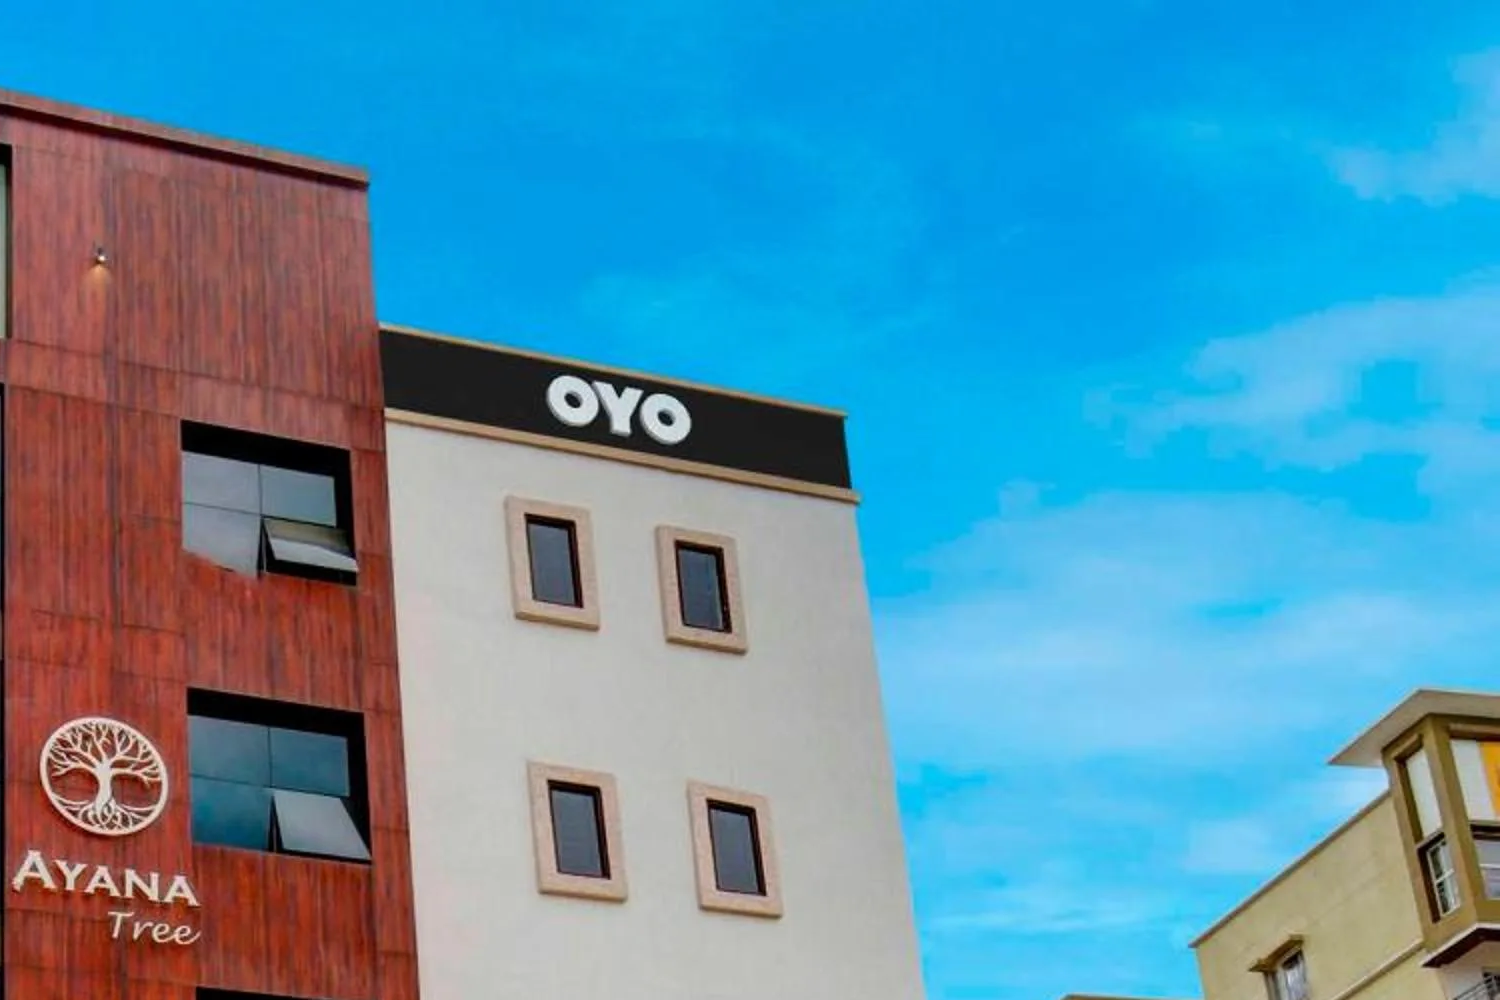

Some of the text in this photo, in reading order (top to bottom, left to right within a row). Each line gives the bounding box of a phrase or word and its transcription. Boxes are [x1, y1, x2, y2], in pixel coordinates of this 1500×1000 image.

[546, 375, 692, 445] OYO
[12, 850, 202, 906] AYANA
[108, 911, 202, 945] Tree
